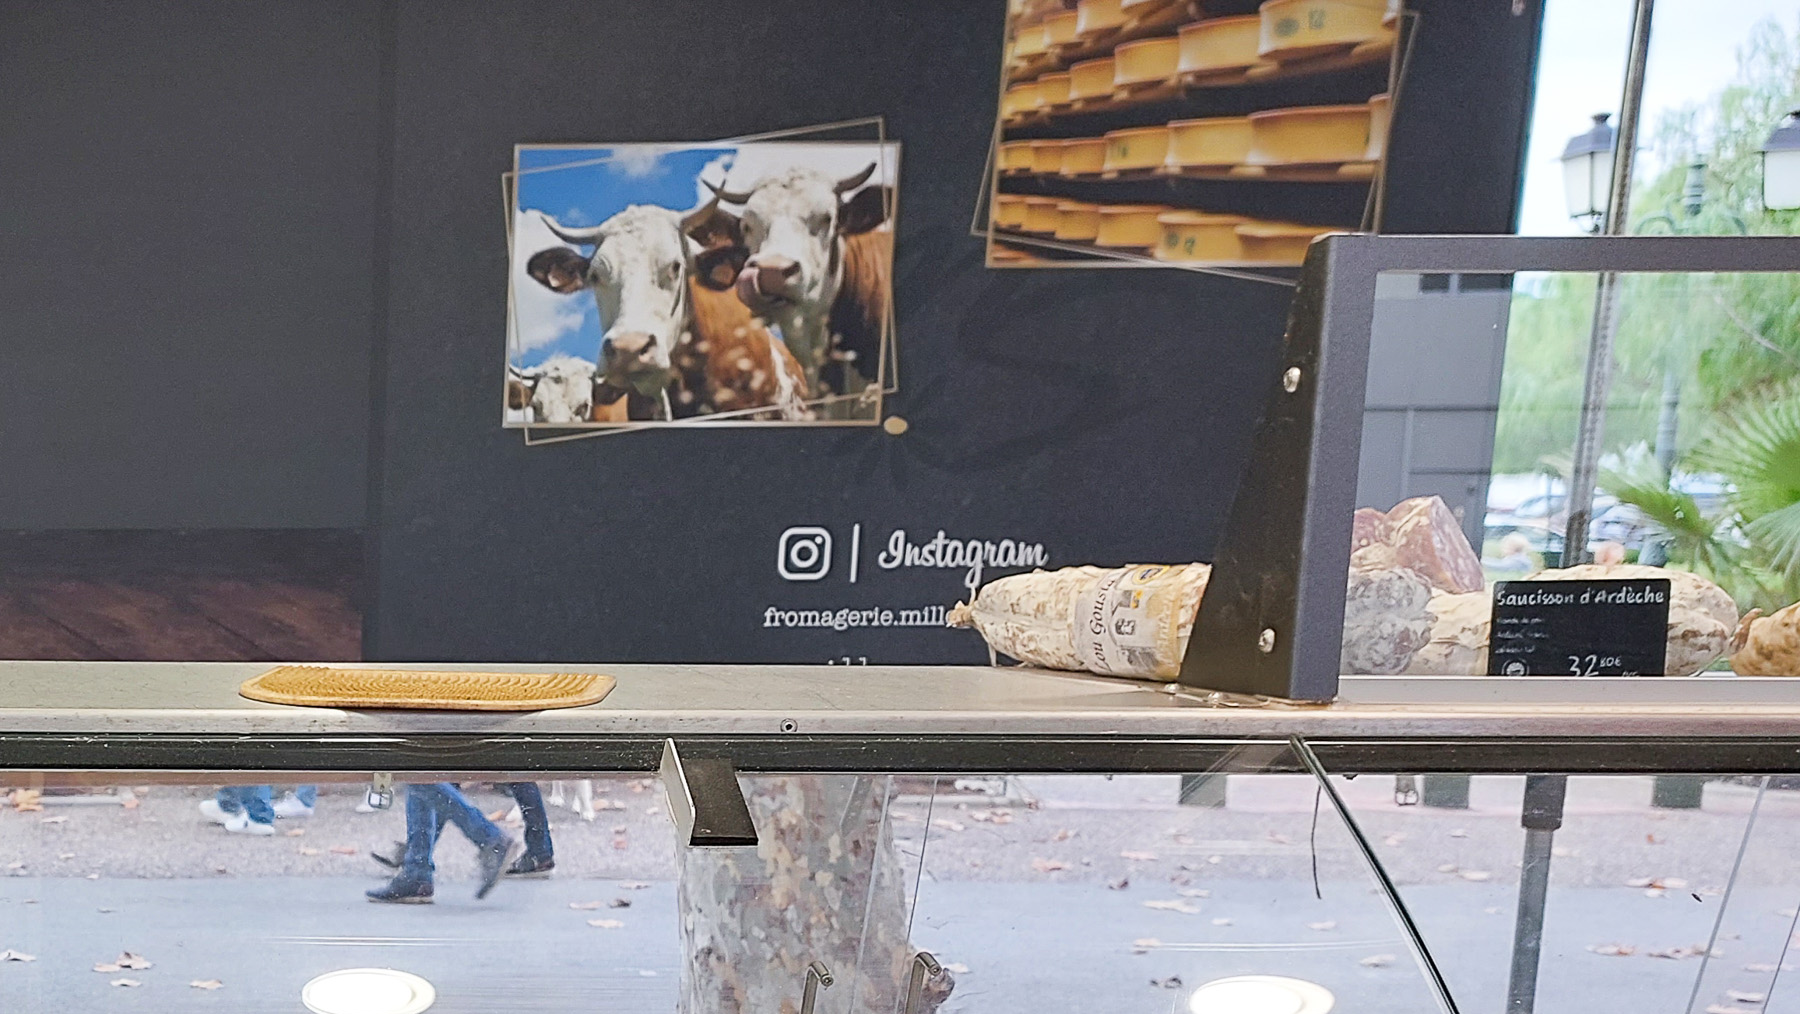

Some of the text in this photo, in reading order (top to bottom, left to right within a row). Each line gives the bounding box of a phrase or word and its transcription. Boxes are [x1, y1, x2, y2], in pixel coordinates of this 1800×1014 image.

[878, 530, 1049, 588] Instagram
[1497, 586, 1664, 606] Saucisson d'Ardèche
